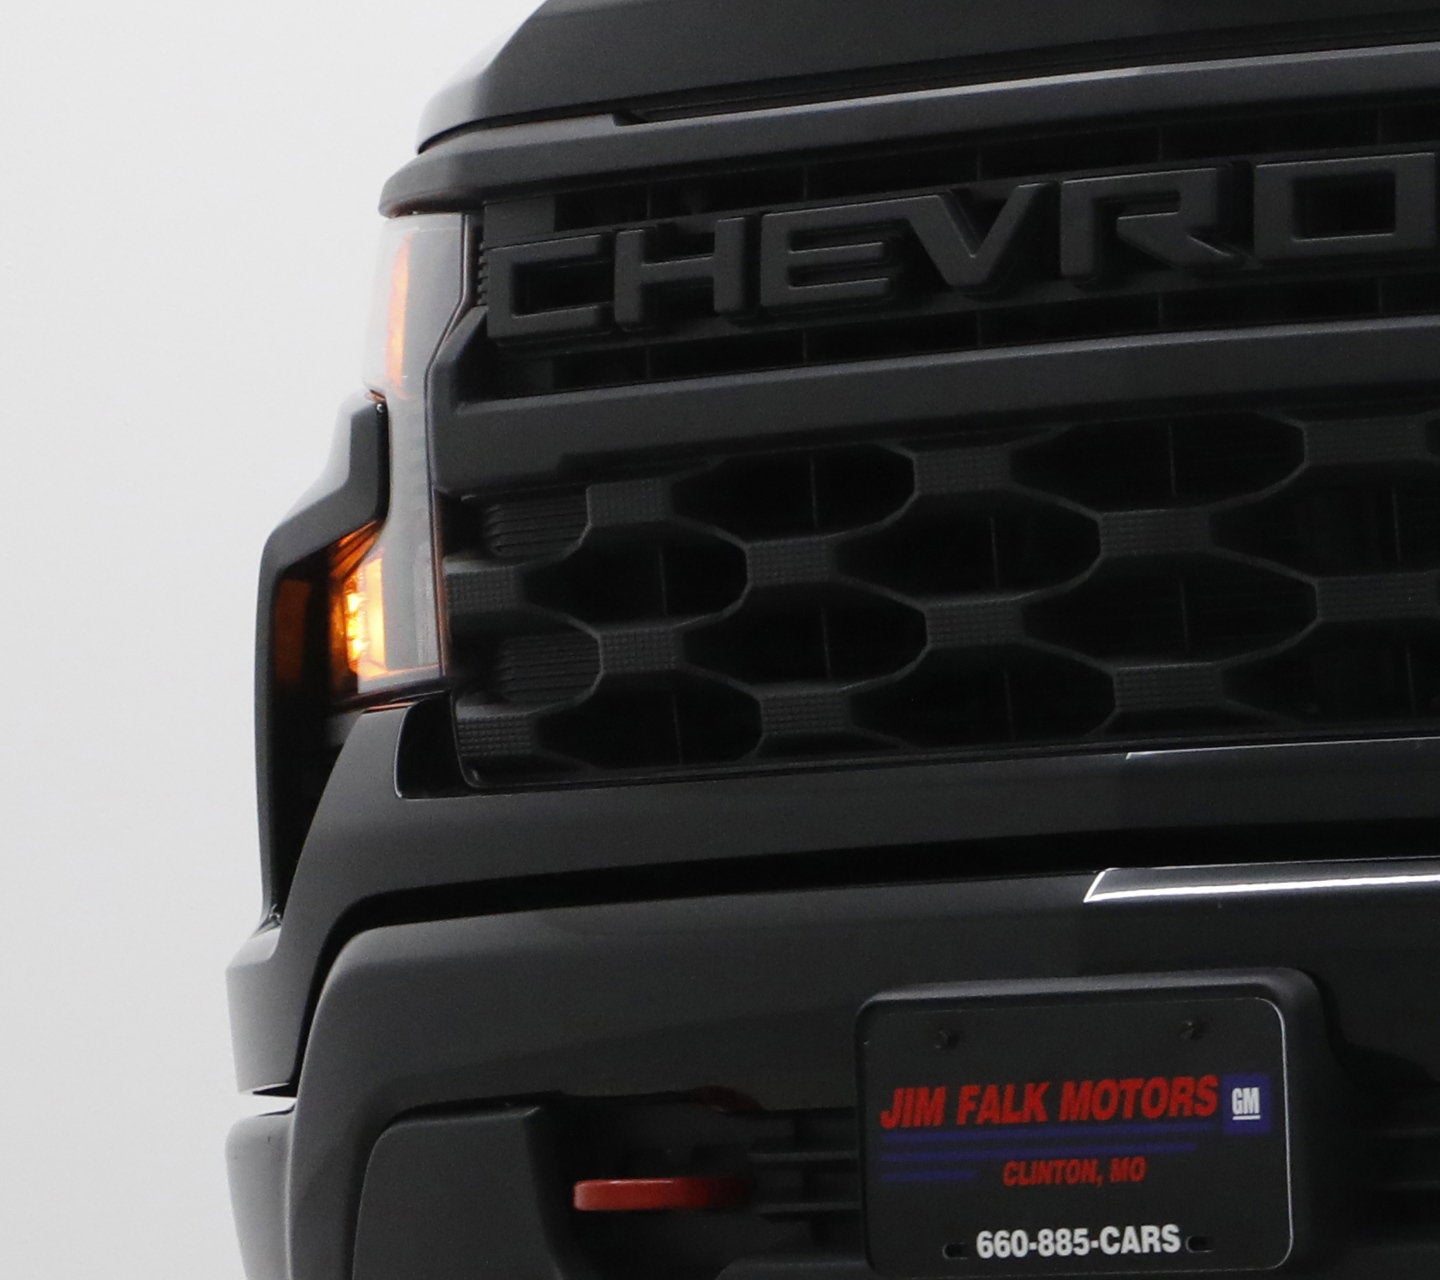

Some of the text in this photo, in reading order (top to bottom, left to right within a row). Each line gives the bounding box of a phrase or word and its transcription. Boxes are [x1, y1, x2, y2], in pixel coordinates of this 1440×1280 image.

[880, 1074, 1219, 1129] JIM FALK MOTORS
[1231, 1086, 1261, 1116] GM
[1003, 1156, 1147, 1187] CLINTON, MO
[975, 1224, 1181, 1260] 660-885-CARS
